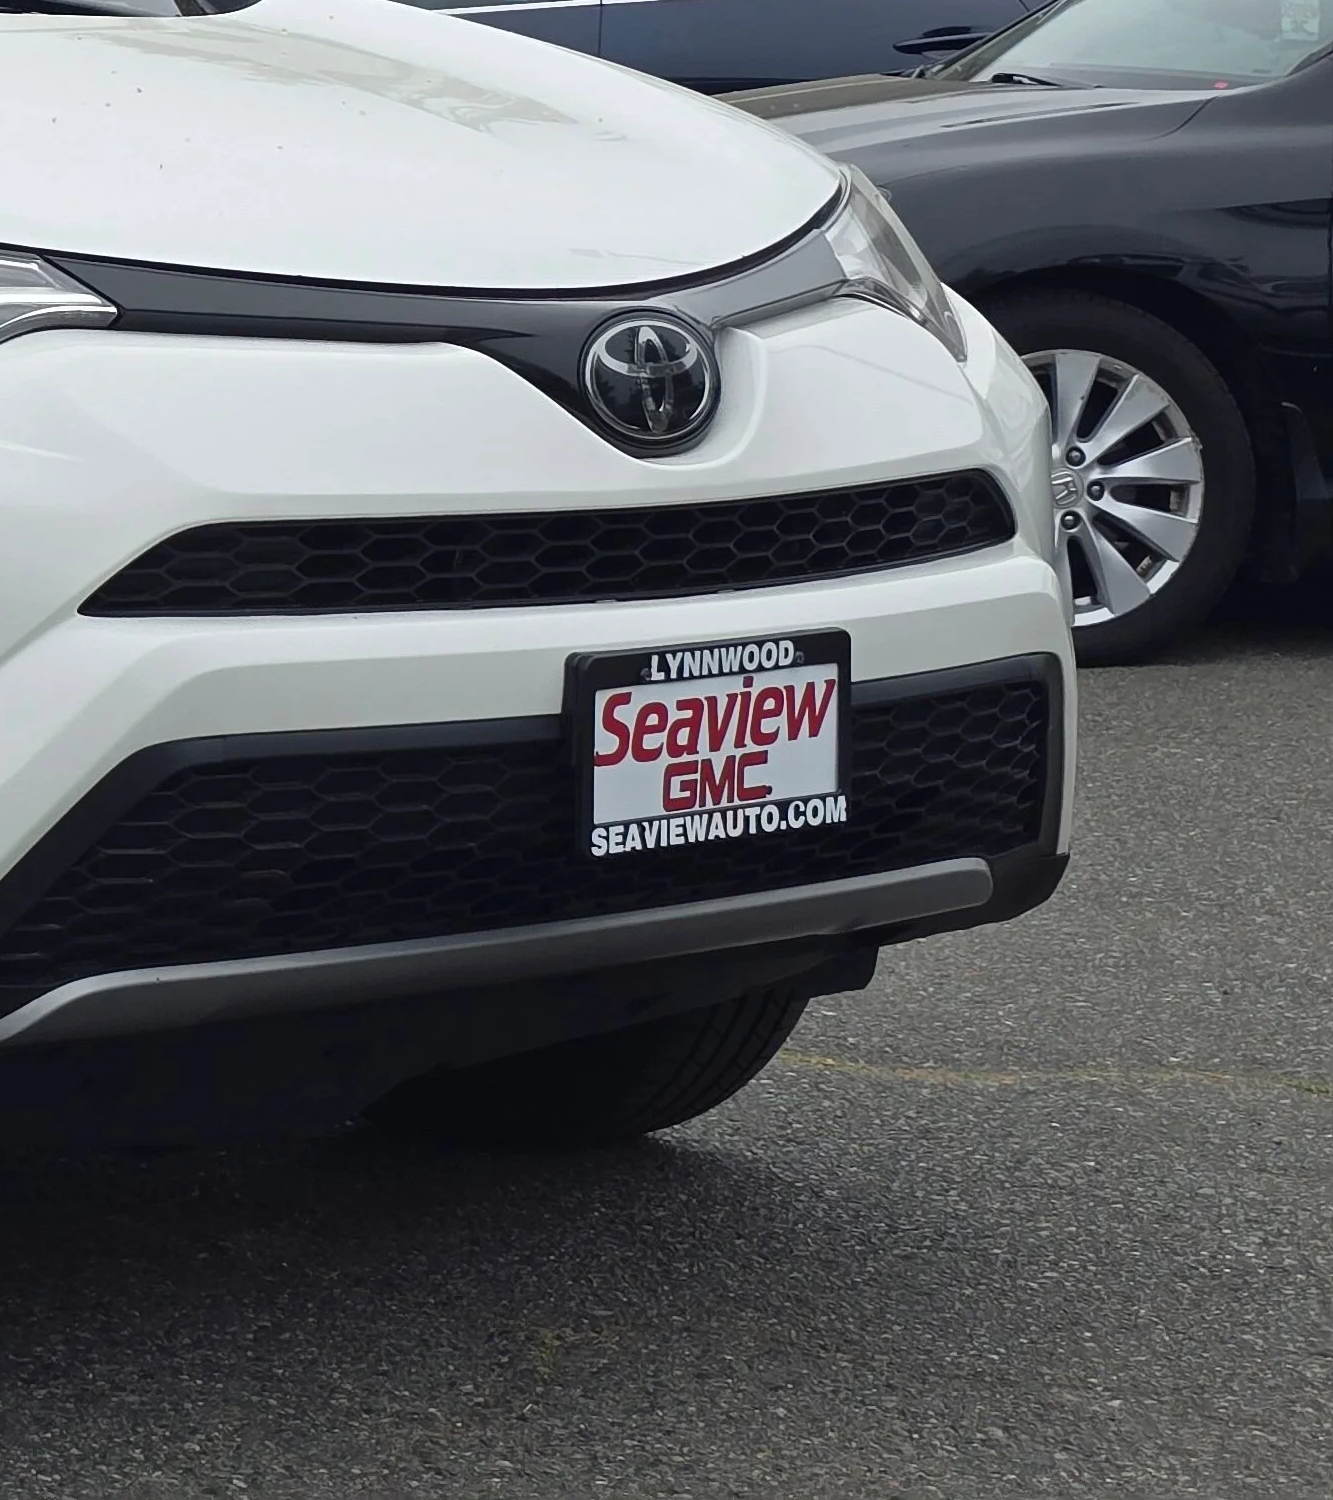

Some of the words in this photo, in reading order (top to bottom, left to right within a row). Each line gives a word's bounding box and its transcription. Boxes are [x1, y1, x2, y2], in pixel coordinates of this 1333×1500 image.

[650, 639, 795, 682] LYNNWOOD
[593, 675, 837, 768] Seaview
[662, 749, 769, 813] GMC
[590, 795, 847, 857] SEAVIEWAUTO.COM
